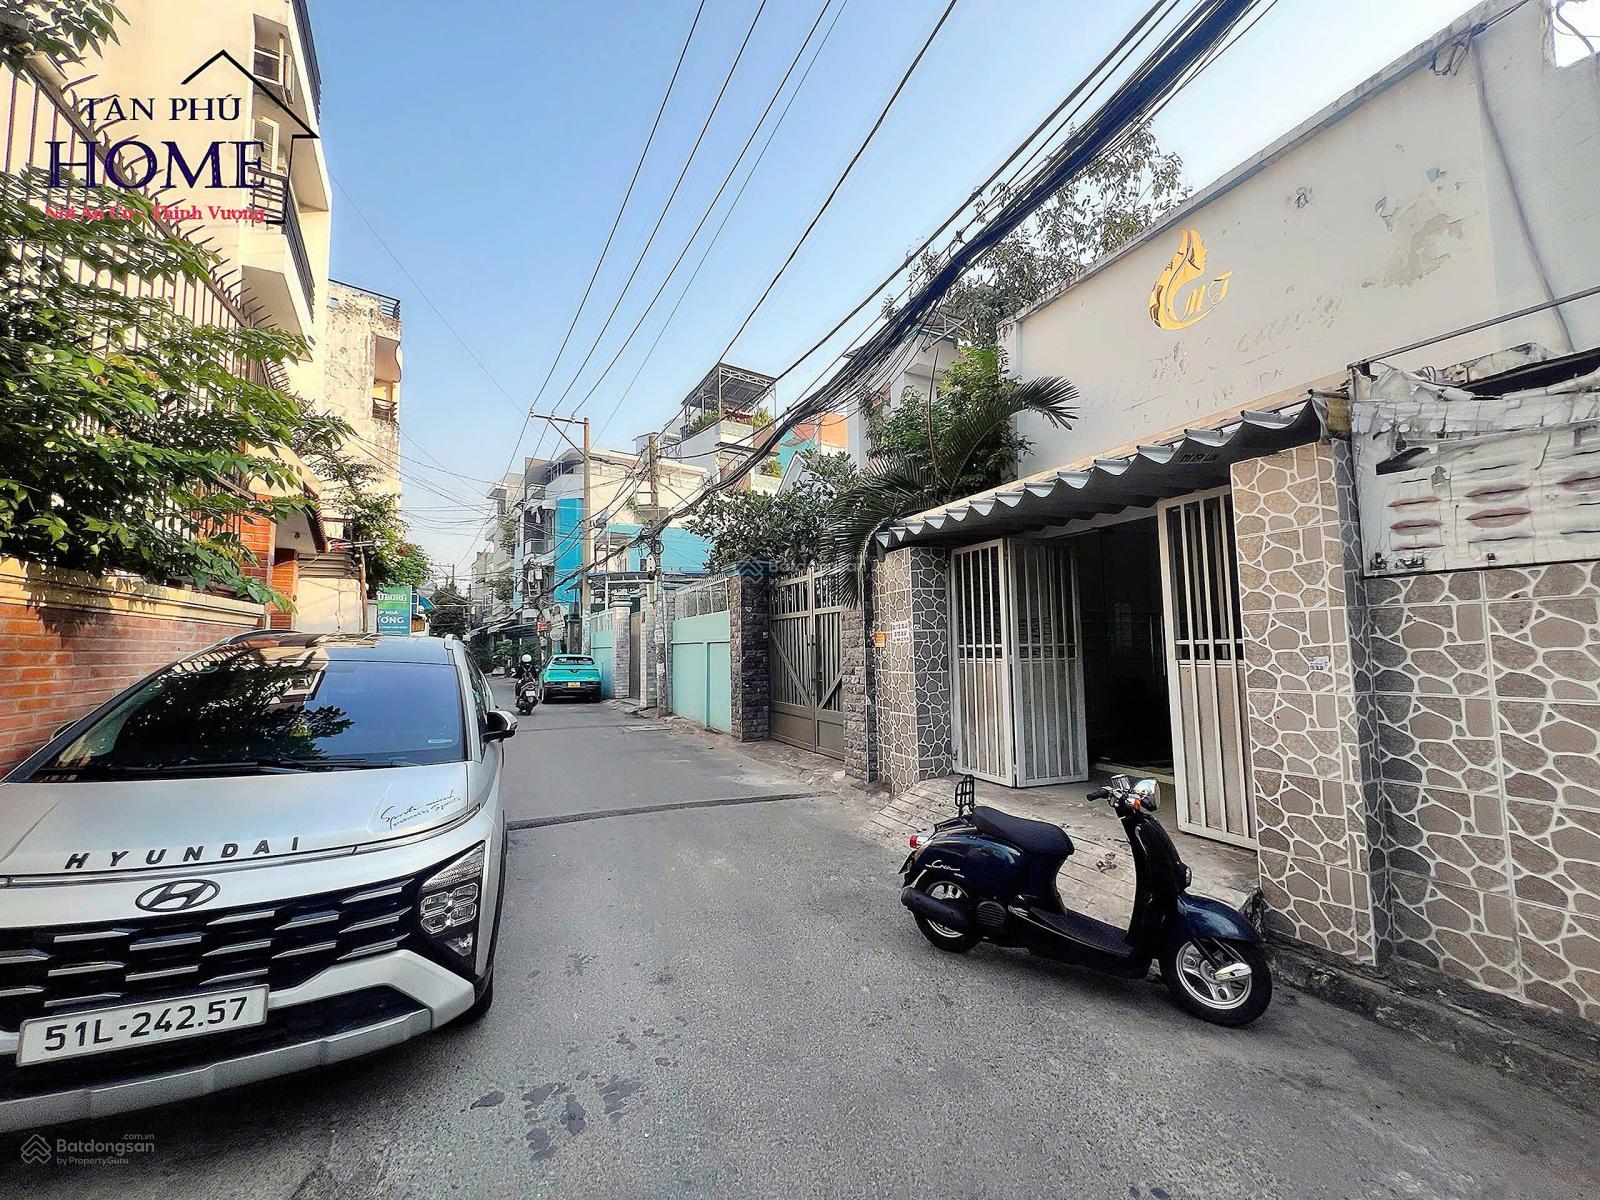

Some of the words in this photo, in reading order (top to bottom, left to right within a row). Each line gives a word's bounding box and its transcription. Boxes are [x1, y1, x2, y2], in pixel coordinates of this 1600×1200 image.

[377, 592, 407, 601] UBORG
[64, 836, 300, 870] HYUNDAI
[44, 996, 248, 1052] 51L-242.57
